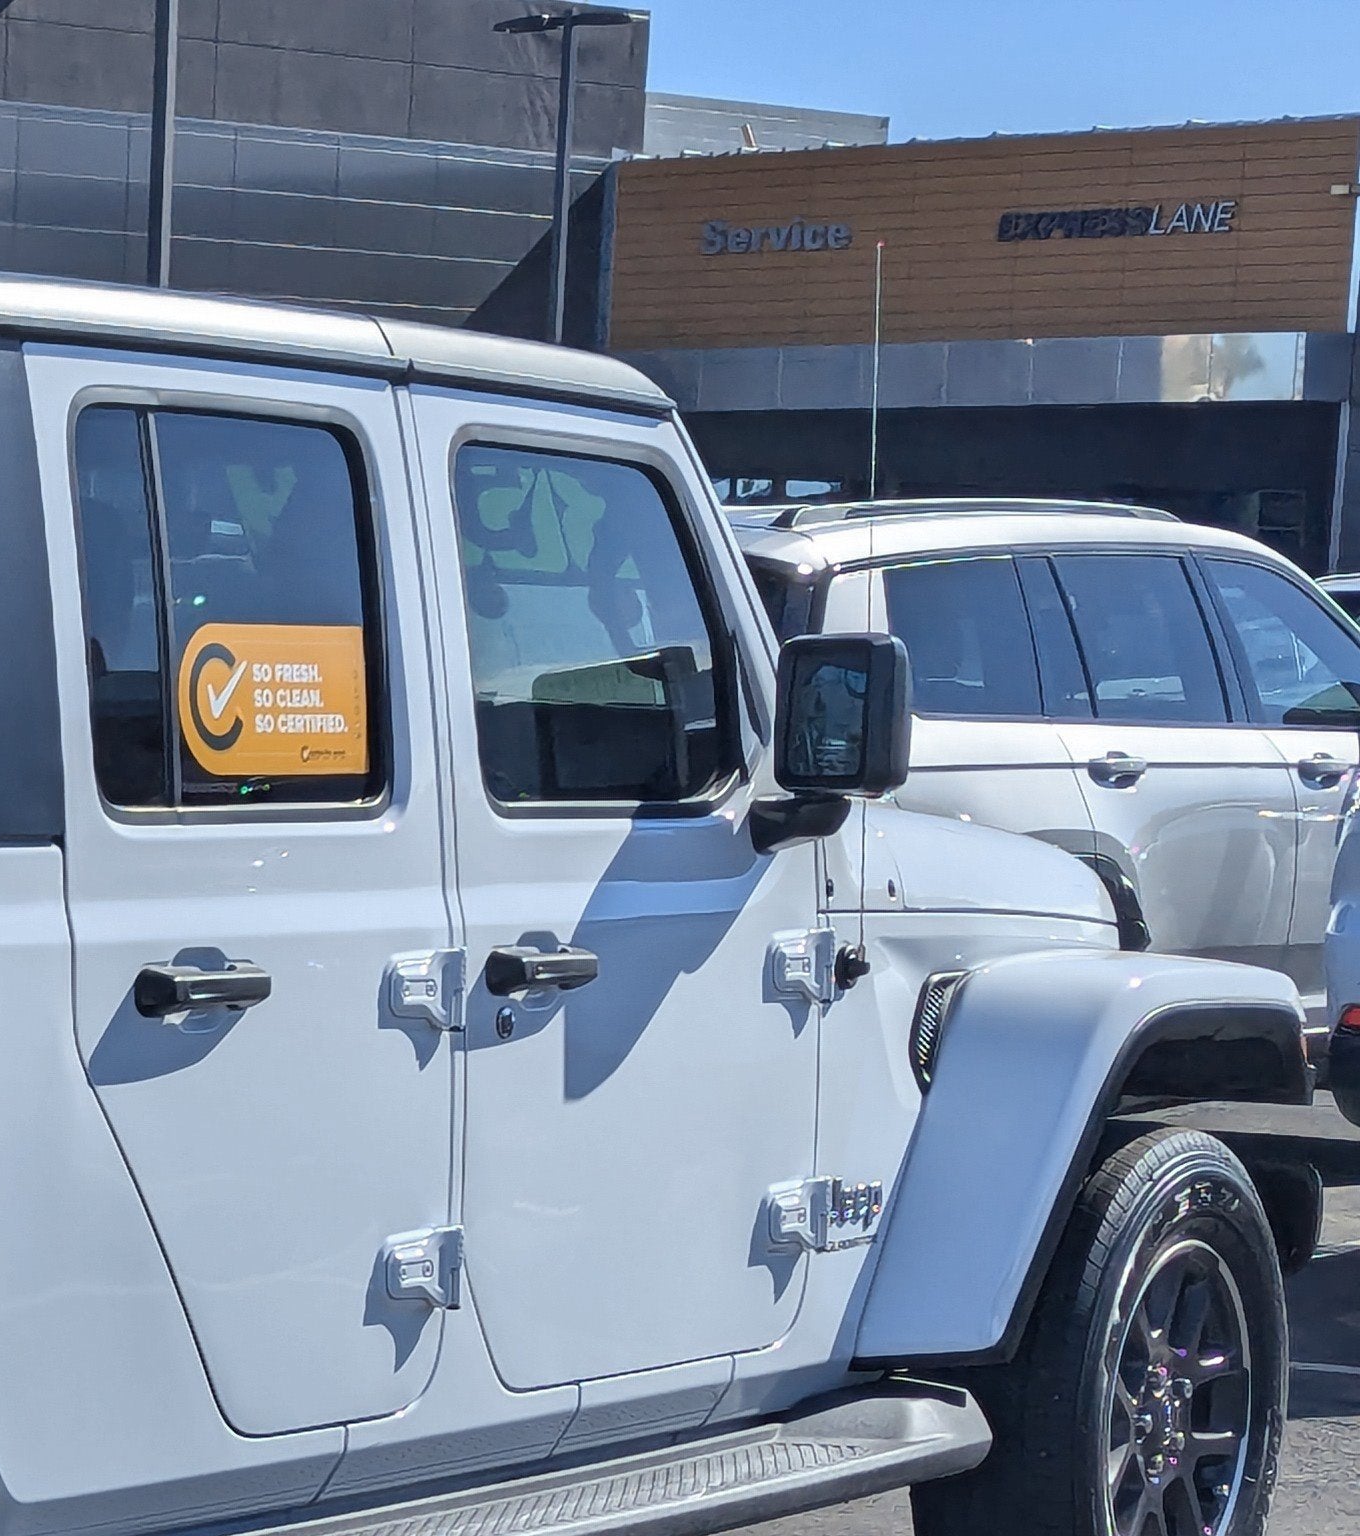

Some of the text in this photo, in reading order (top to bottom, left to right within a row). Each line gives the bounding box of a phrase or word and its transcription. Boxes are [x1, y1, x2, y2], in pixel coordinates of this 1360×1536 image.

[701, 217, 854, 255] Service
[252, 664, 323, 684] SO FRESH.
[253, 688, 324, 707] SO CLEAN.
[255, 714, 349, 734] SO CERTIFIED.
